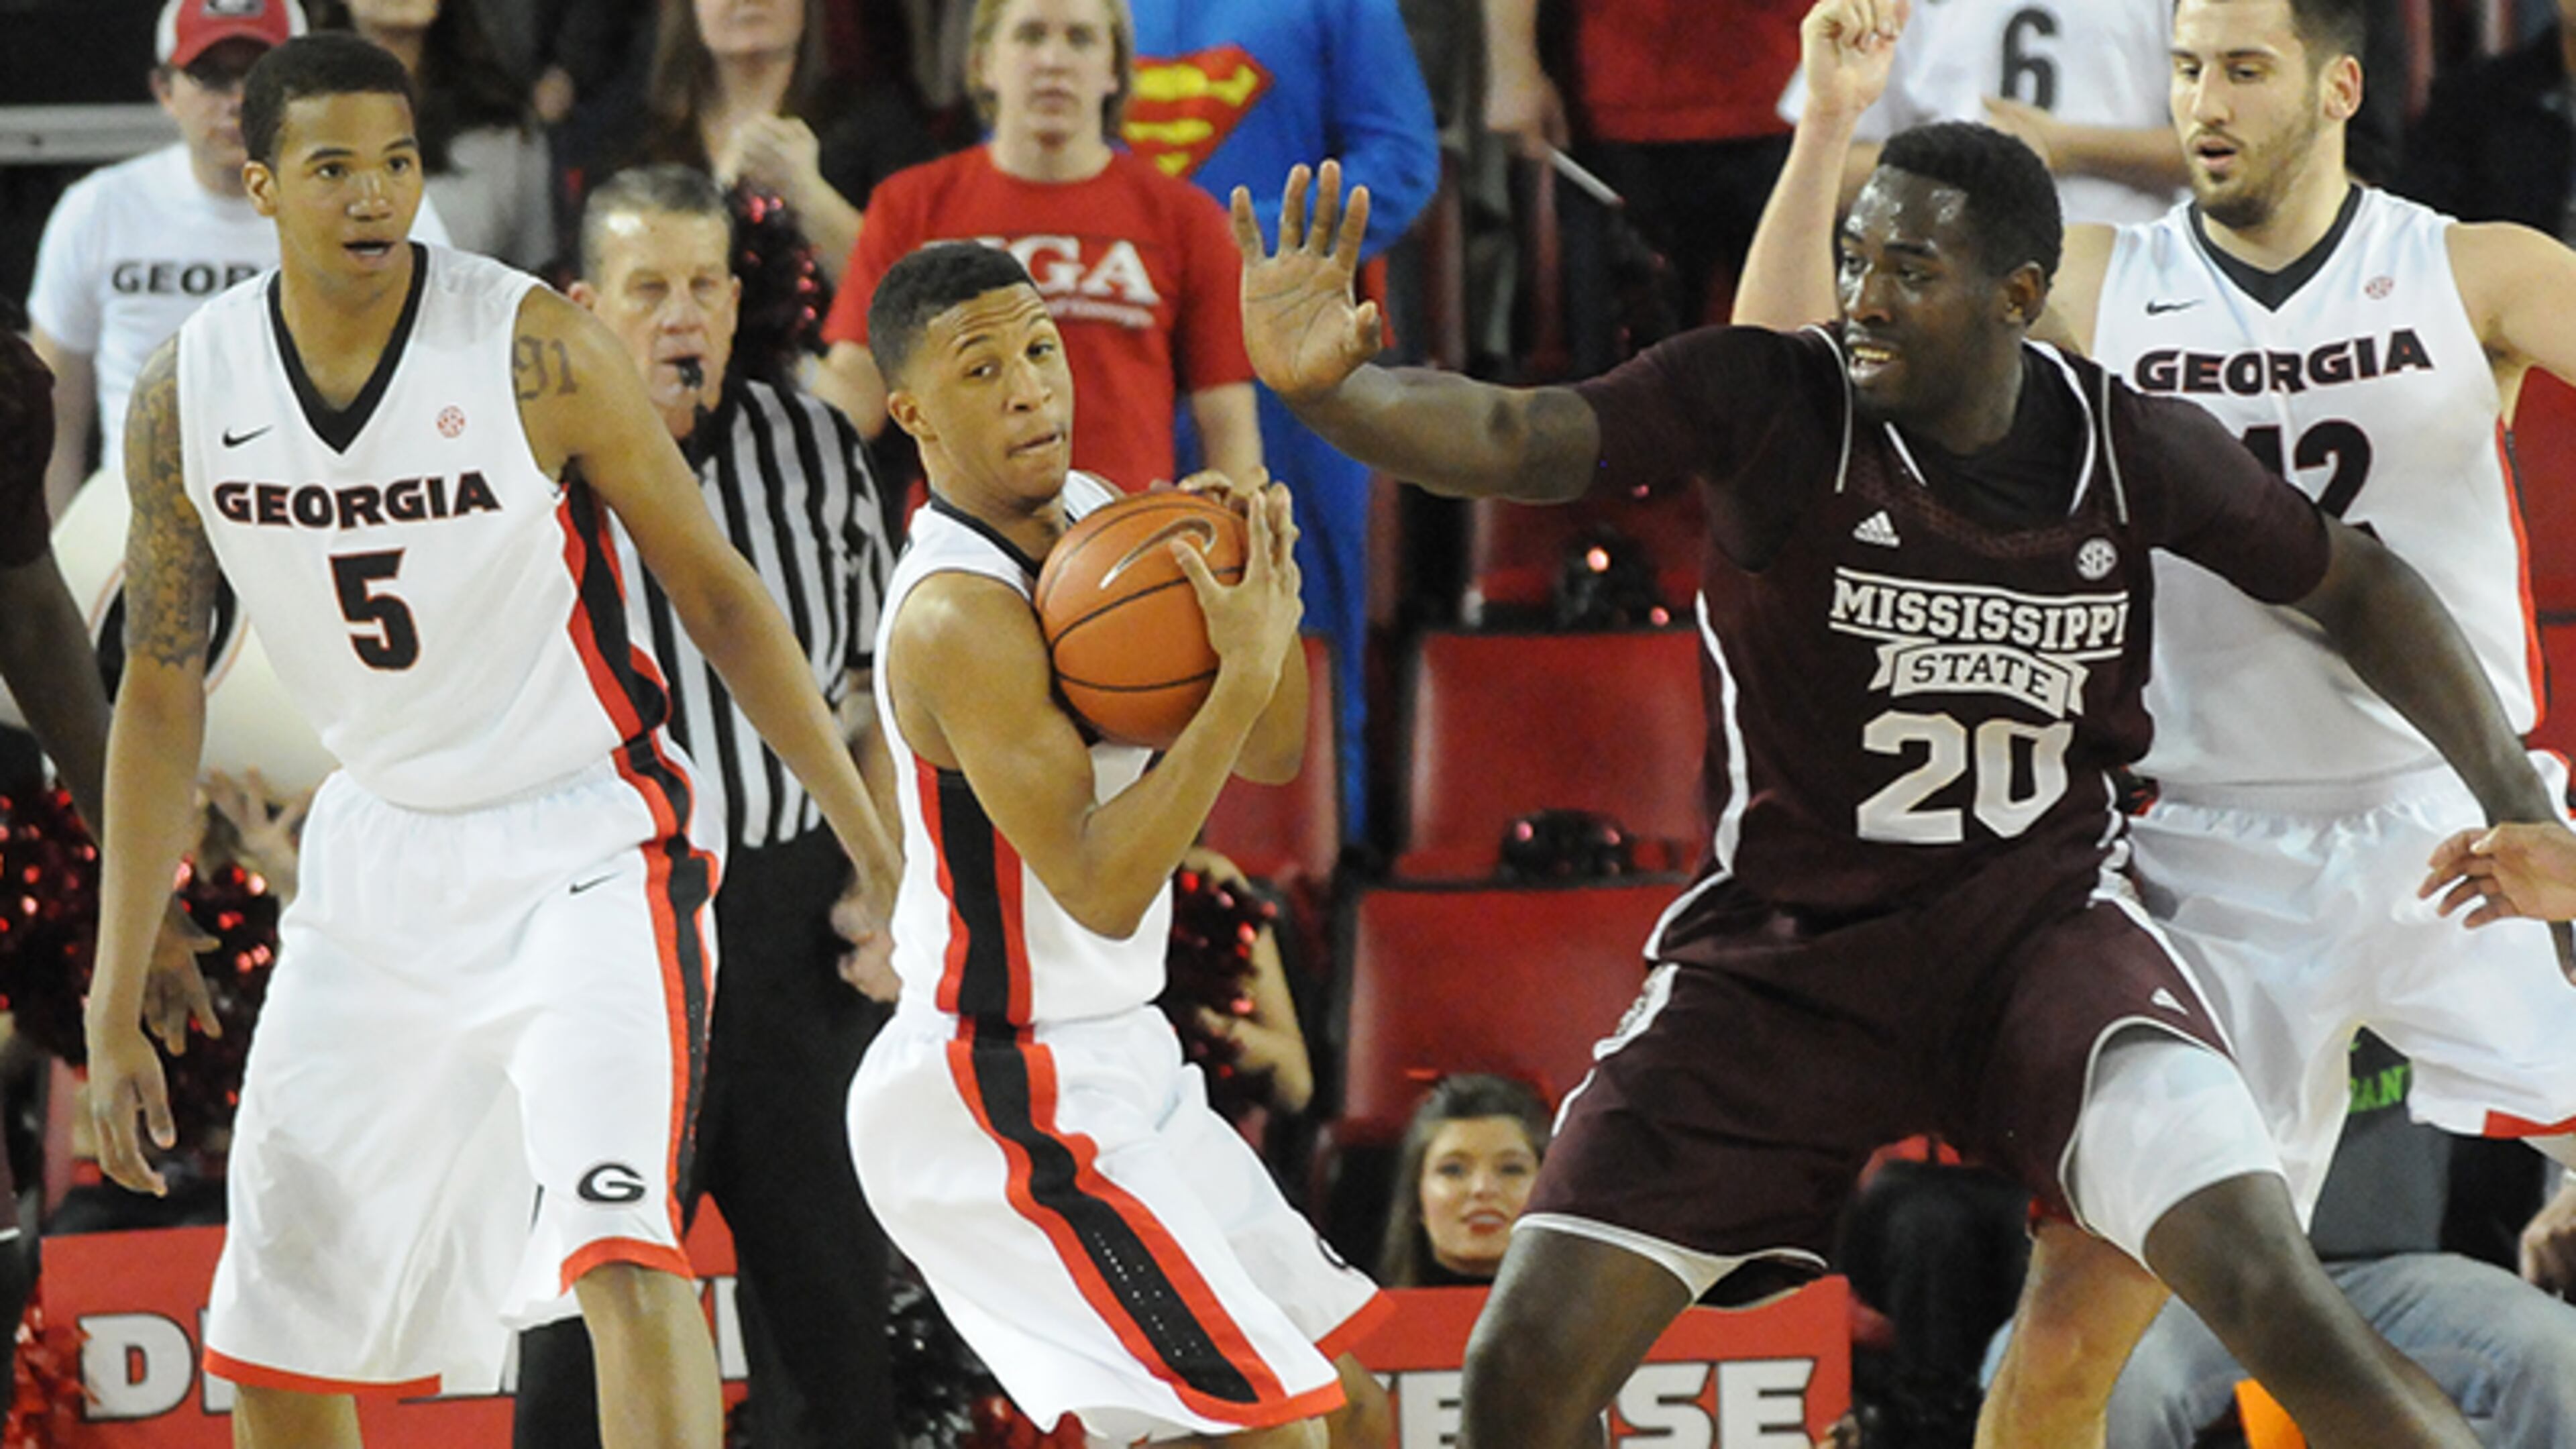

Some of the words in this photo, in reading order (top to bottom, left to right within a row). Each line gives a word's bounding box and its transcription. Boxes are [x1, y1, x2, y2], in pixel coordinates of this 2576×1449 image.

[2001, 7, 2055, 111] 6
[2135, 329, 2434, 396] GEORGIA
[213, 470, 503, 530] GEORGIA
[328, 547, 420, 672] 5
[1829, 577, 2129, 651] MISSISSIPPI
[1911, 654, 2052, 702] STATE
[1856, 710, 2074, 844] 20
[578, 1162, 645, 1203] G
